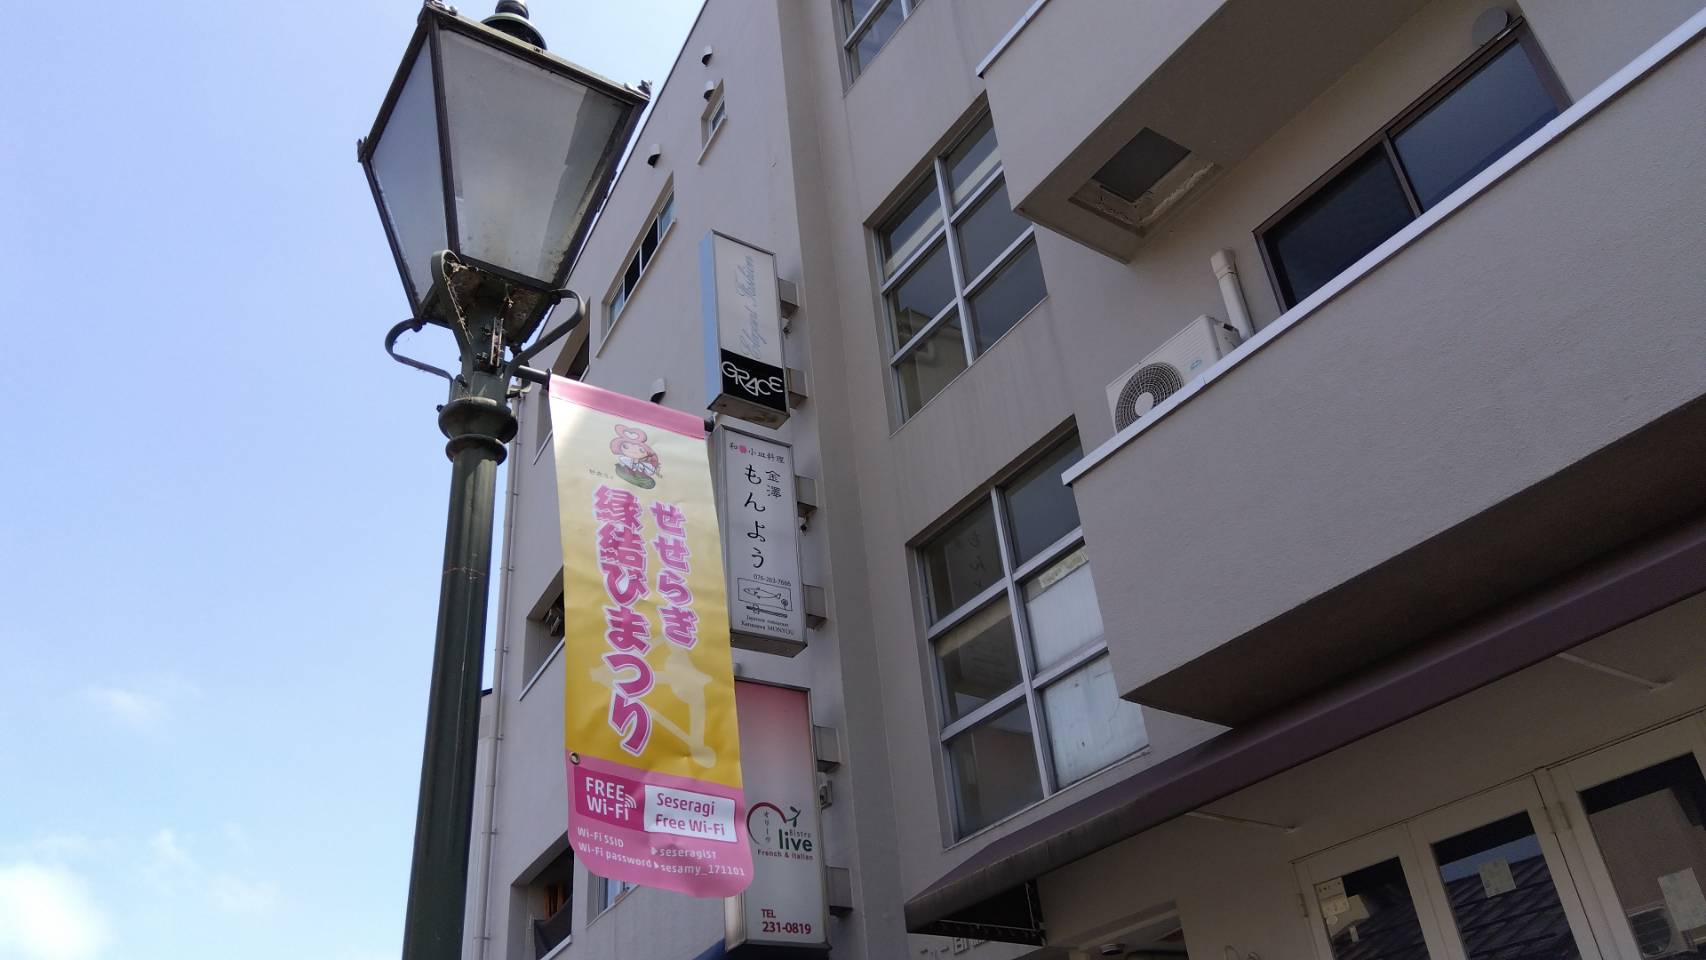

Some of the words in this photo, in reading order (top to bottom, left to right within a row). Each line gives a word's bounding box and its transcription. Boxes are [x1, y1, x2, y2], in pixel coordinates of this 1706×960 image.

[721, 361, 784, 397] GRACE
[744, 463, 766, 569] もんよう
[649, 498, 701, 650] せせらぎ
[592, 483, 656, 758] 縁結びまつり
[585, 776, 625, 799] FREE
[586, 795, 629, 821] Wi-Fi
[656, 792, 715, 816] Seseragi
[577, 825, 602, 842] Wi-Fi
[604, 834, 624, 848] SSID
[655, 813, 686, 832] Free
[688, 816, 725, 836] Wi-Fi
[578, 841, 603, 857] Wi-Fi
[605, 850, 651, 869] password
[757, 849, 782, 857] French
[761, 908, 777, 919] TEL
[762, 921, 812, 935] 231-0819
